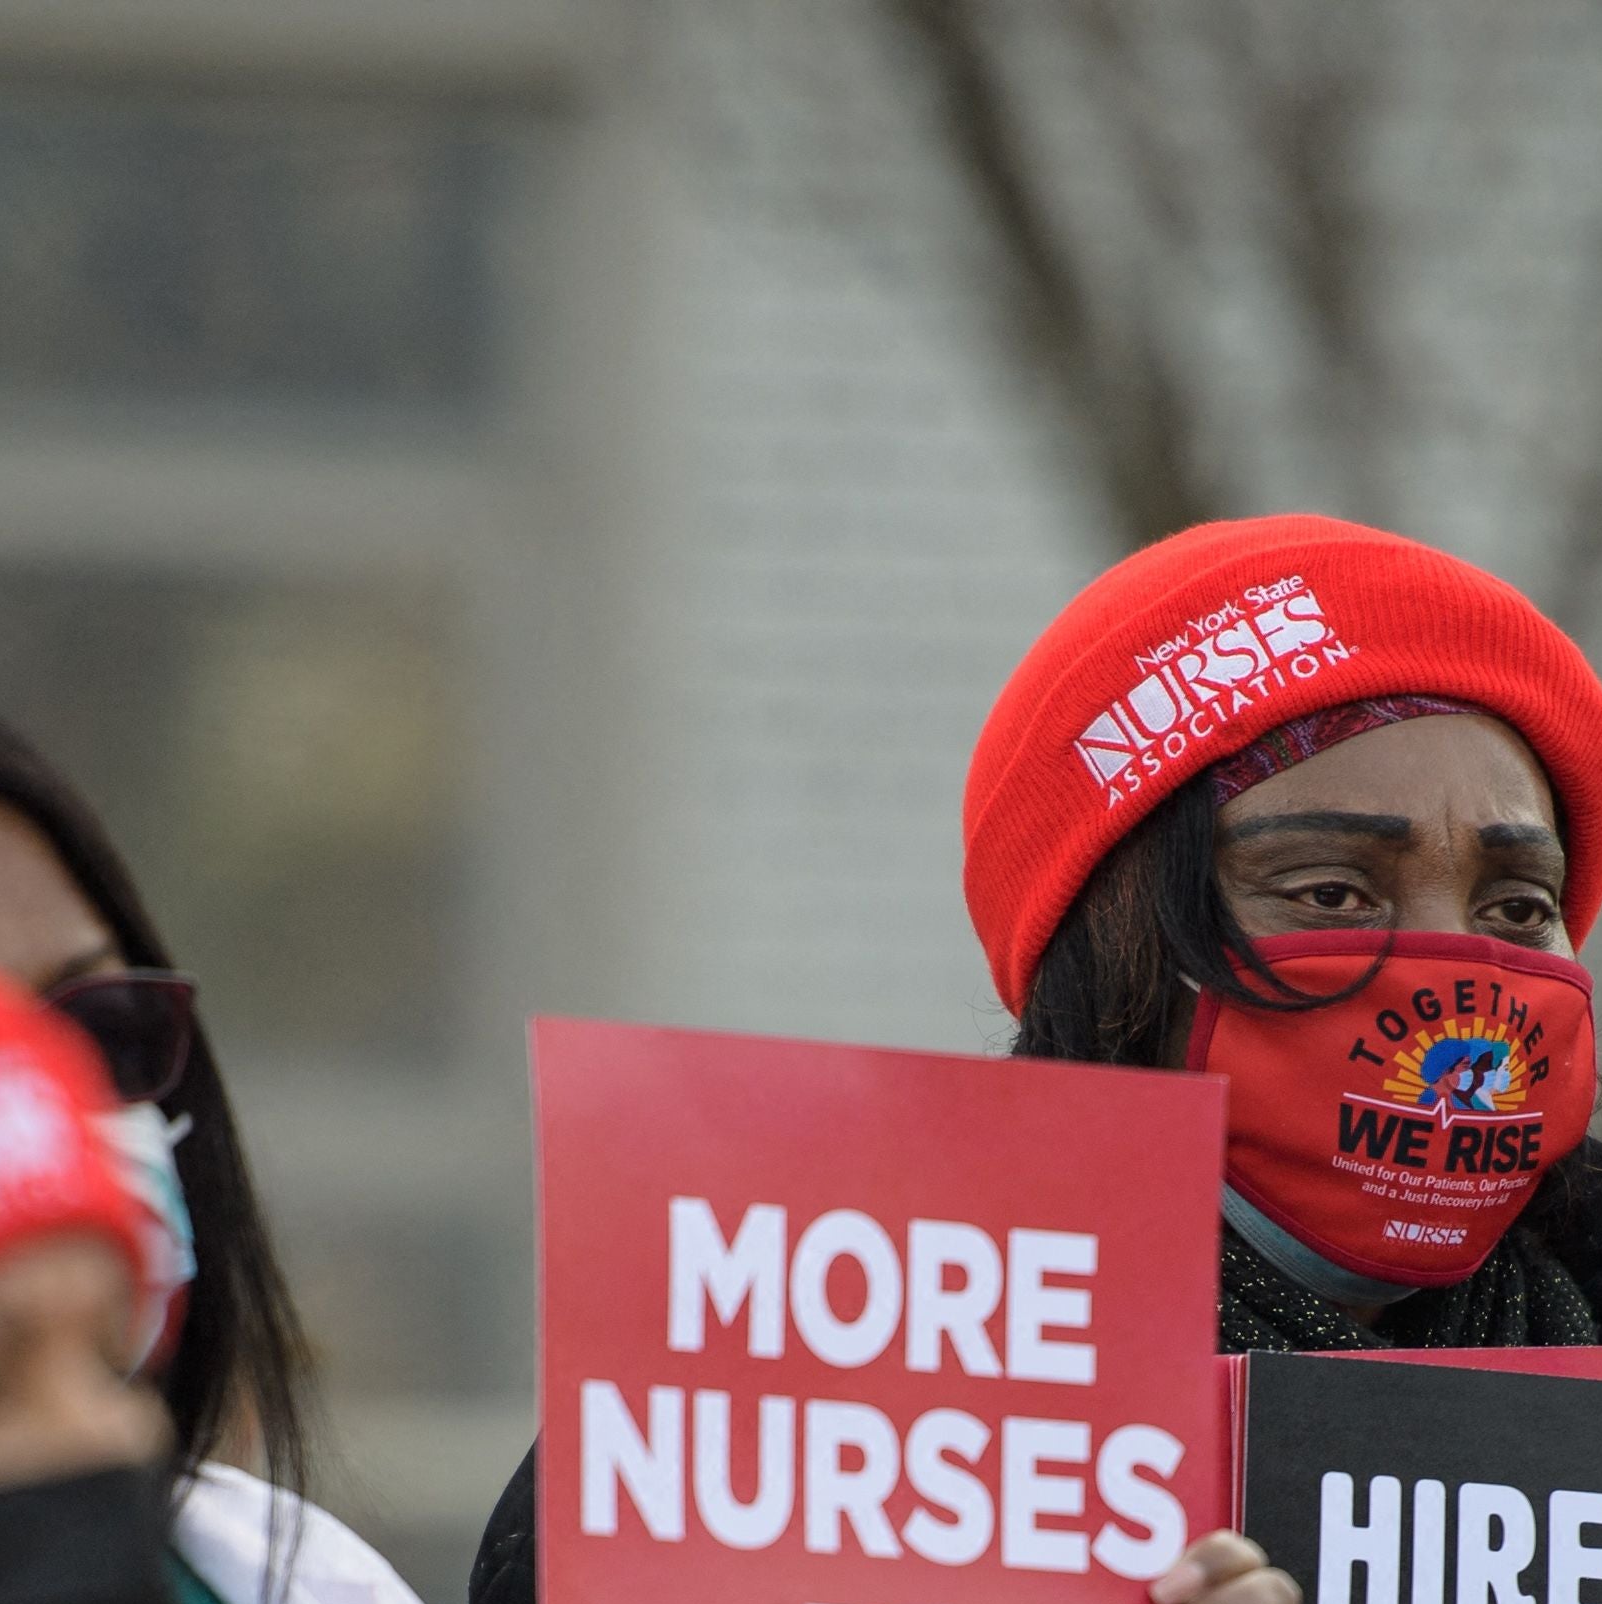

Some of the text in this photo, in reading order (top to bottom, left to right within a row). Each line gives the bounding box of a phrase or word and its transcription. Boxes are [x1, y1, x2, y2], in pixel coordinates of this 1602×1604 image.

[1134, 575, 1305, 674] New York State
[1074, 589, 1335, 788] NURSES
[1348, 979, 1550, 1087] TOGETHER
[1332, 1155, 1374, 1178] United
[1376, 1166, 1396, 1182] for
[1399, 1171, 1422, 1187] Our
[1425, 1177, 1476, 1194] Patients,
[1479, 1178, 1498, 1192] Our
[1338, 1103, 1543, 1174] WE RISE
[1362, 1180, 1385, 1196] and
[1388, 1188, 1398, 1199] a
[1399, 1189, 1428, 1205] Just
[1430, 1193, 1483, 1211] Recovery
[1483, 1195, 1498, 1208] for
[1382, 1219, 1468, 1245] NURSES
[666, 1195, 1099, 1386] MORE
[579, 1379, 1188, 1581] NURSES
